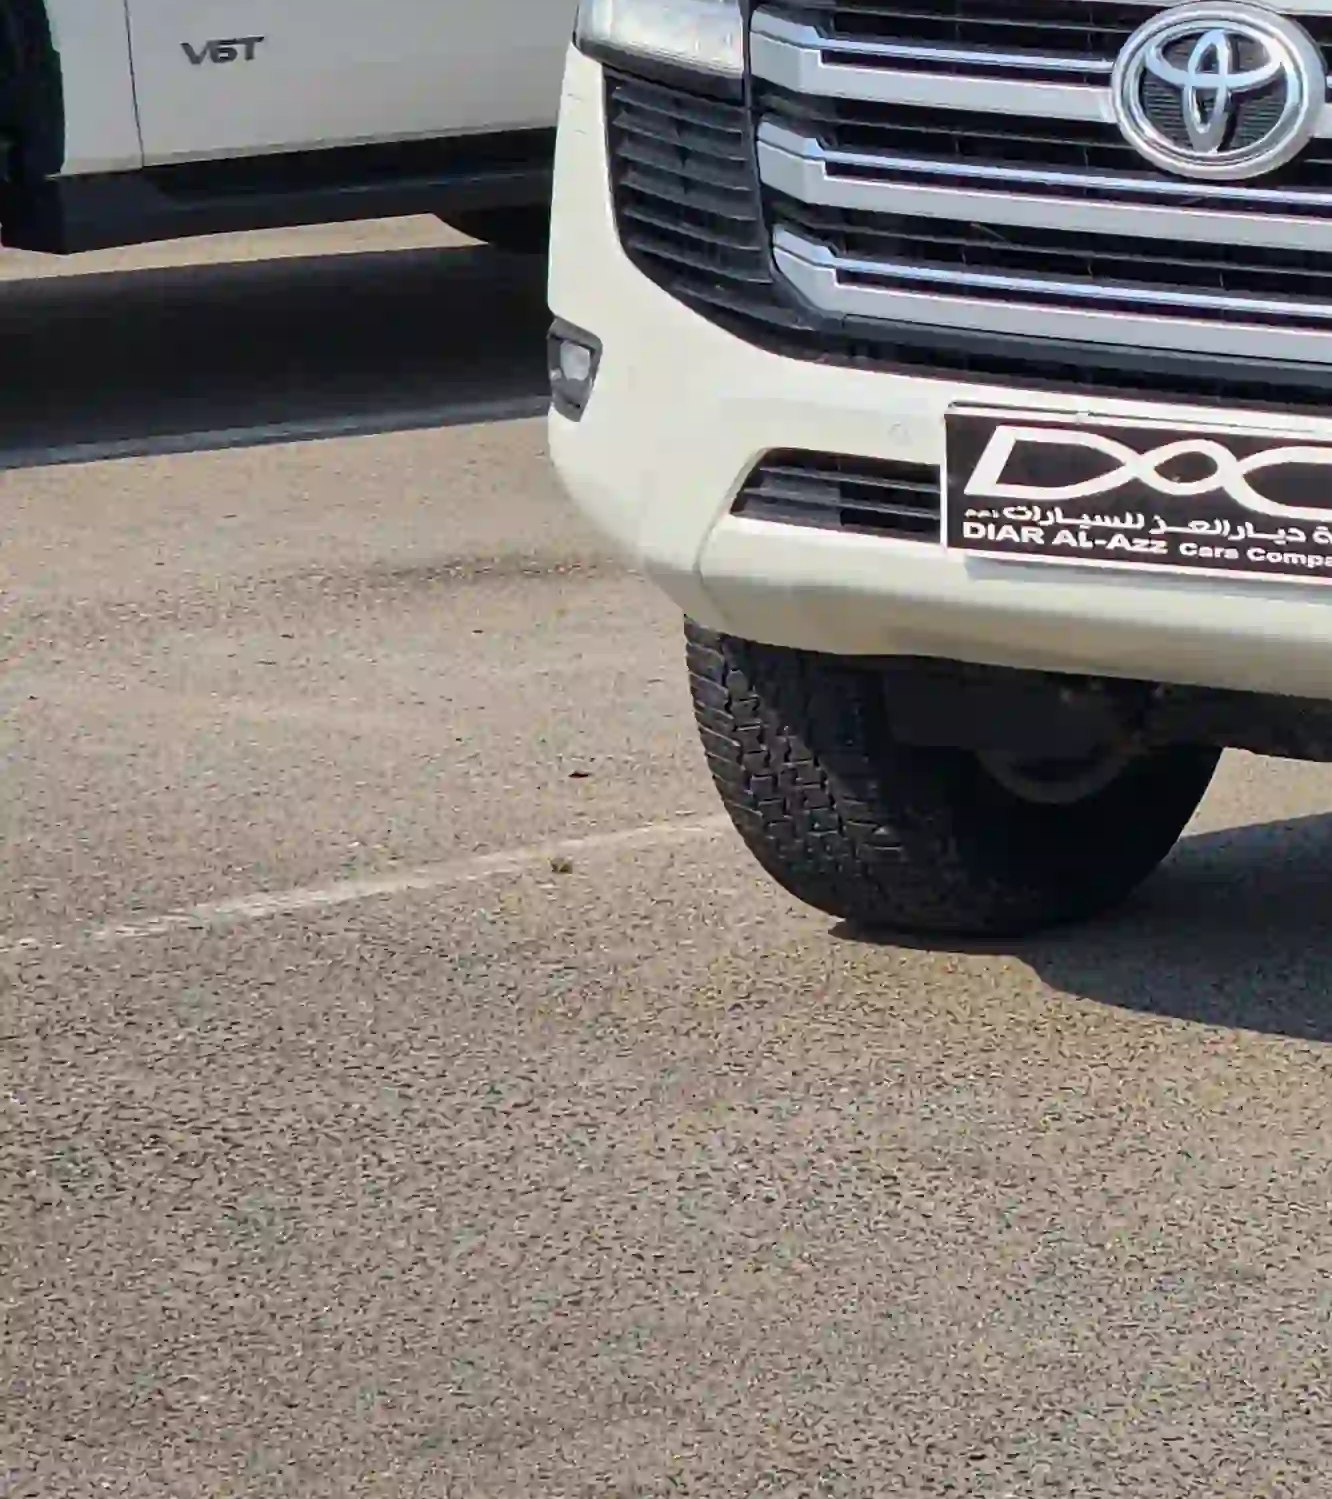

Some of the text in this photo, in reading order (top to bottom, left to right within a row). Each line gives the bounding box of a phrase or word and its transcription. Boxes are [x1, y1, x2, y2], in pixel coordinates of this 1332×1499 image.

[179, 34, 265, 65] V6T
[1002, 504, 1146, 530] للسيارات
[962, 521, 1046, 545] DIAR
[1179, 541, 1240, 560] Cars
